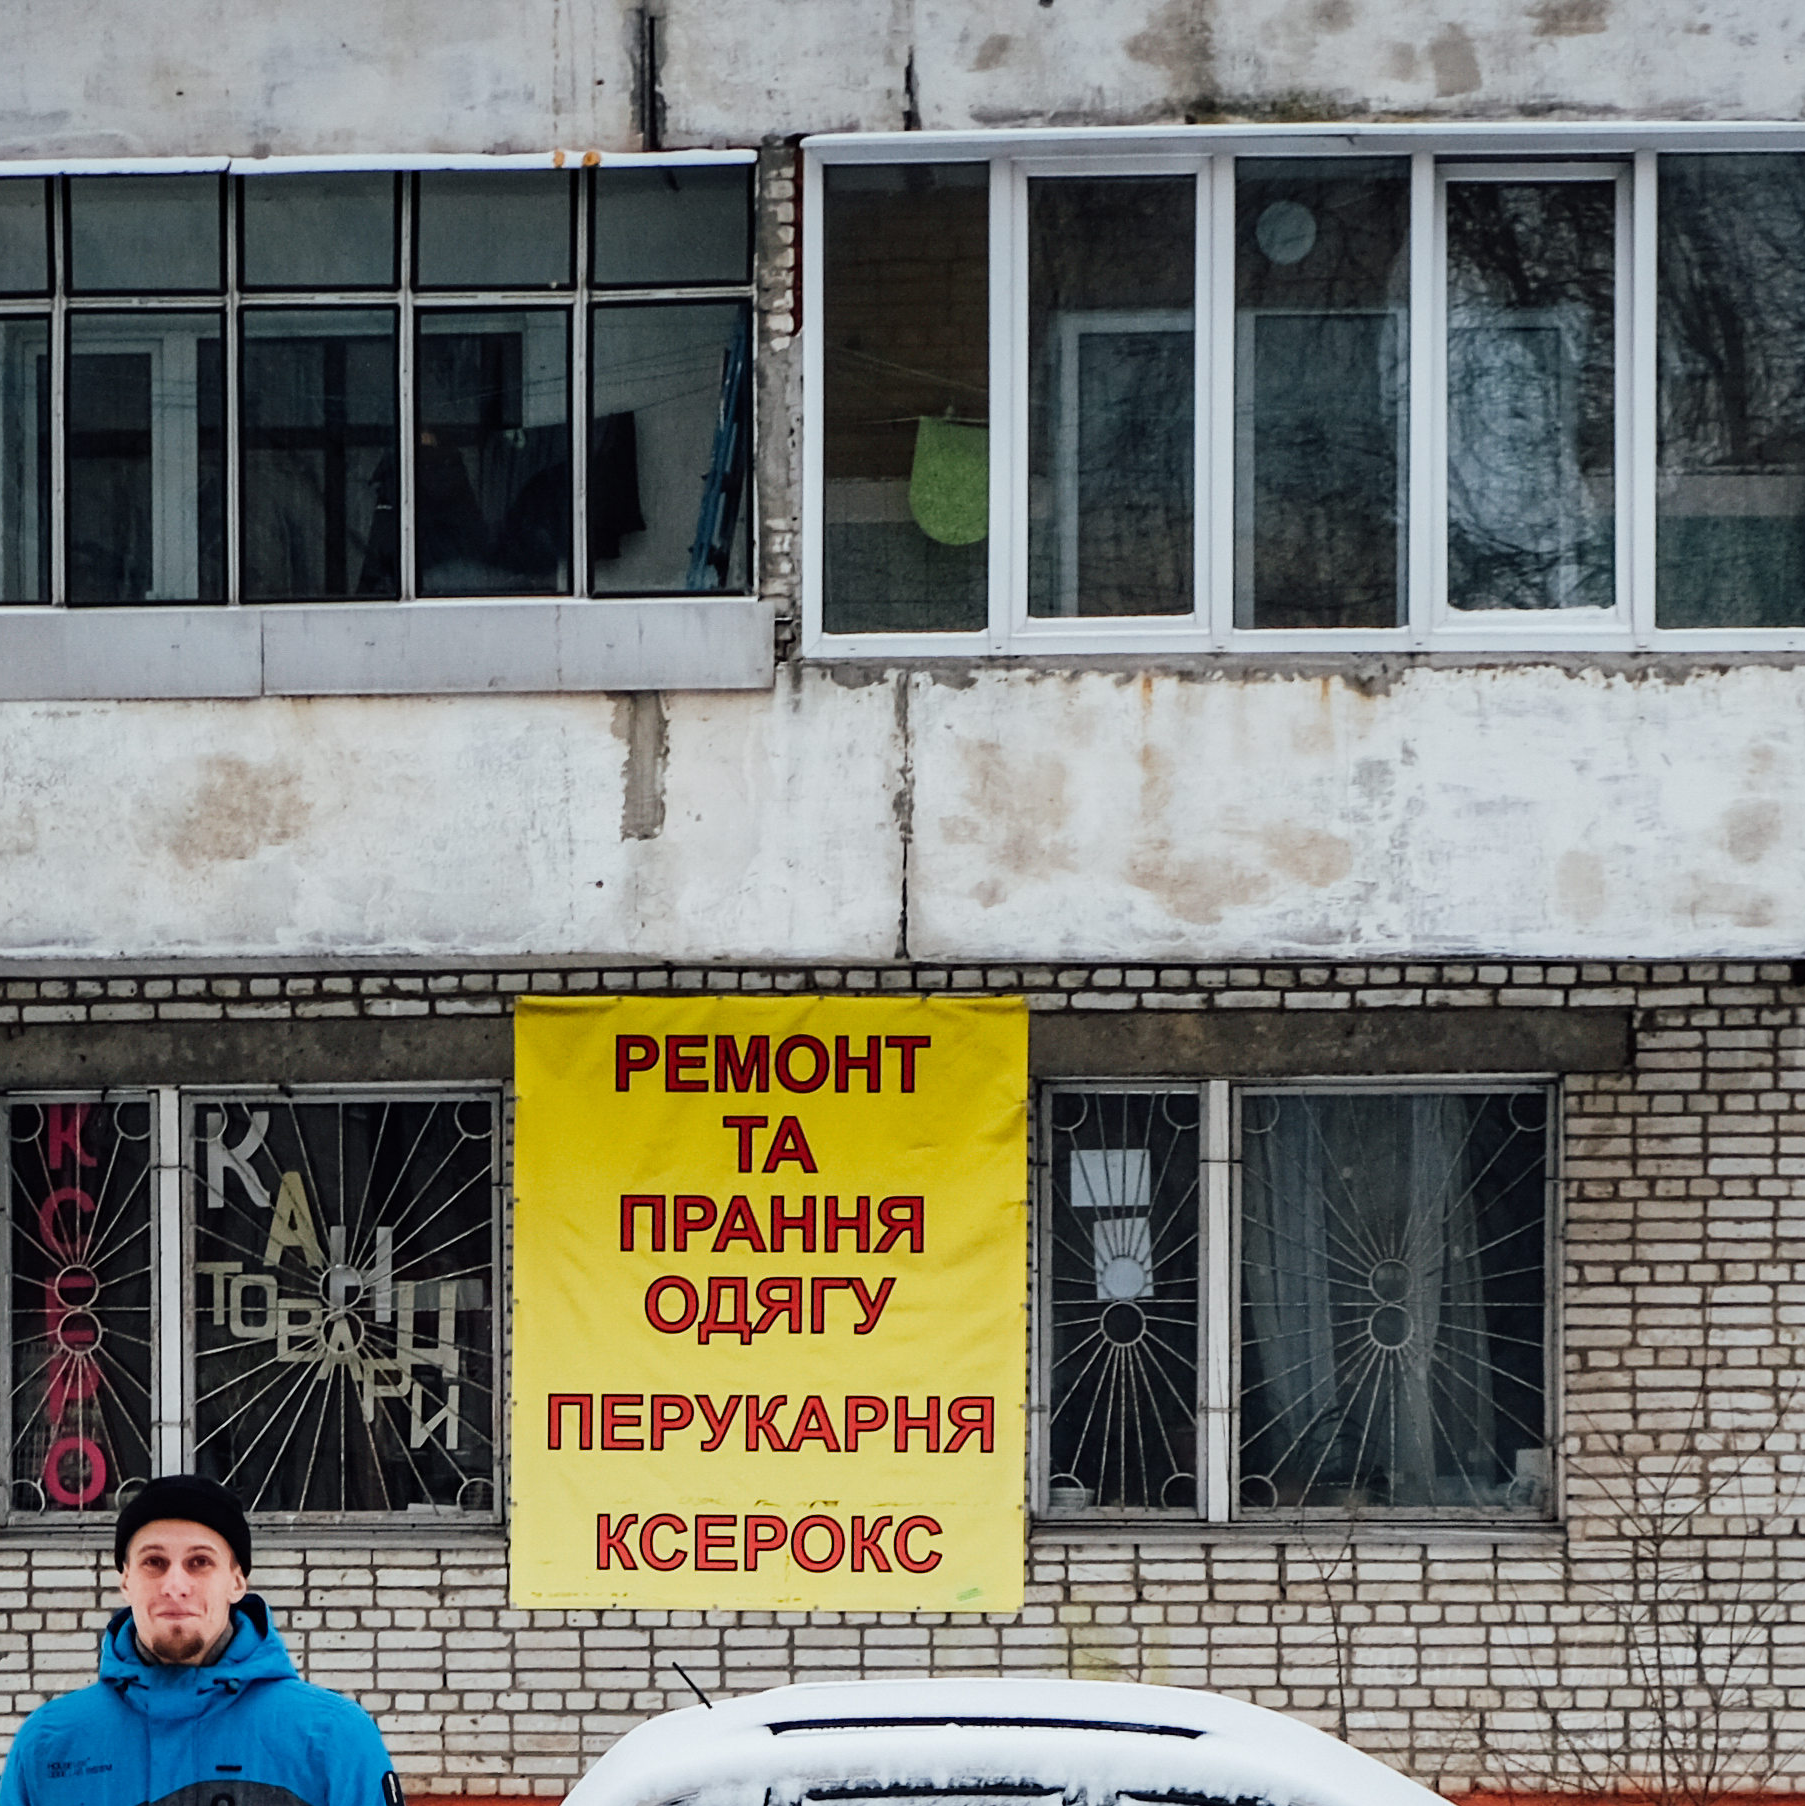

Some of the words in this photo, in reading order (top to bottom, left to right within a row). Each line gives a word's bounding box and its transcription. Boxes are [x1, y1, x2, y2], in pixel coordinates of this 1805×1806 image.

[614, 1034, 931, 1093] РЕМОНТ
[723, 1115, 818, 1174] ТА
[619, 1194, 925, 1254] ПРАННЯ
[644, 1275, 897, 1346] ОДЯГУ
[547, 1393, 995, 1454] ПЕРУКАРНЯ
[596, 1513, 944, 1574] КСЕРОКС
